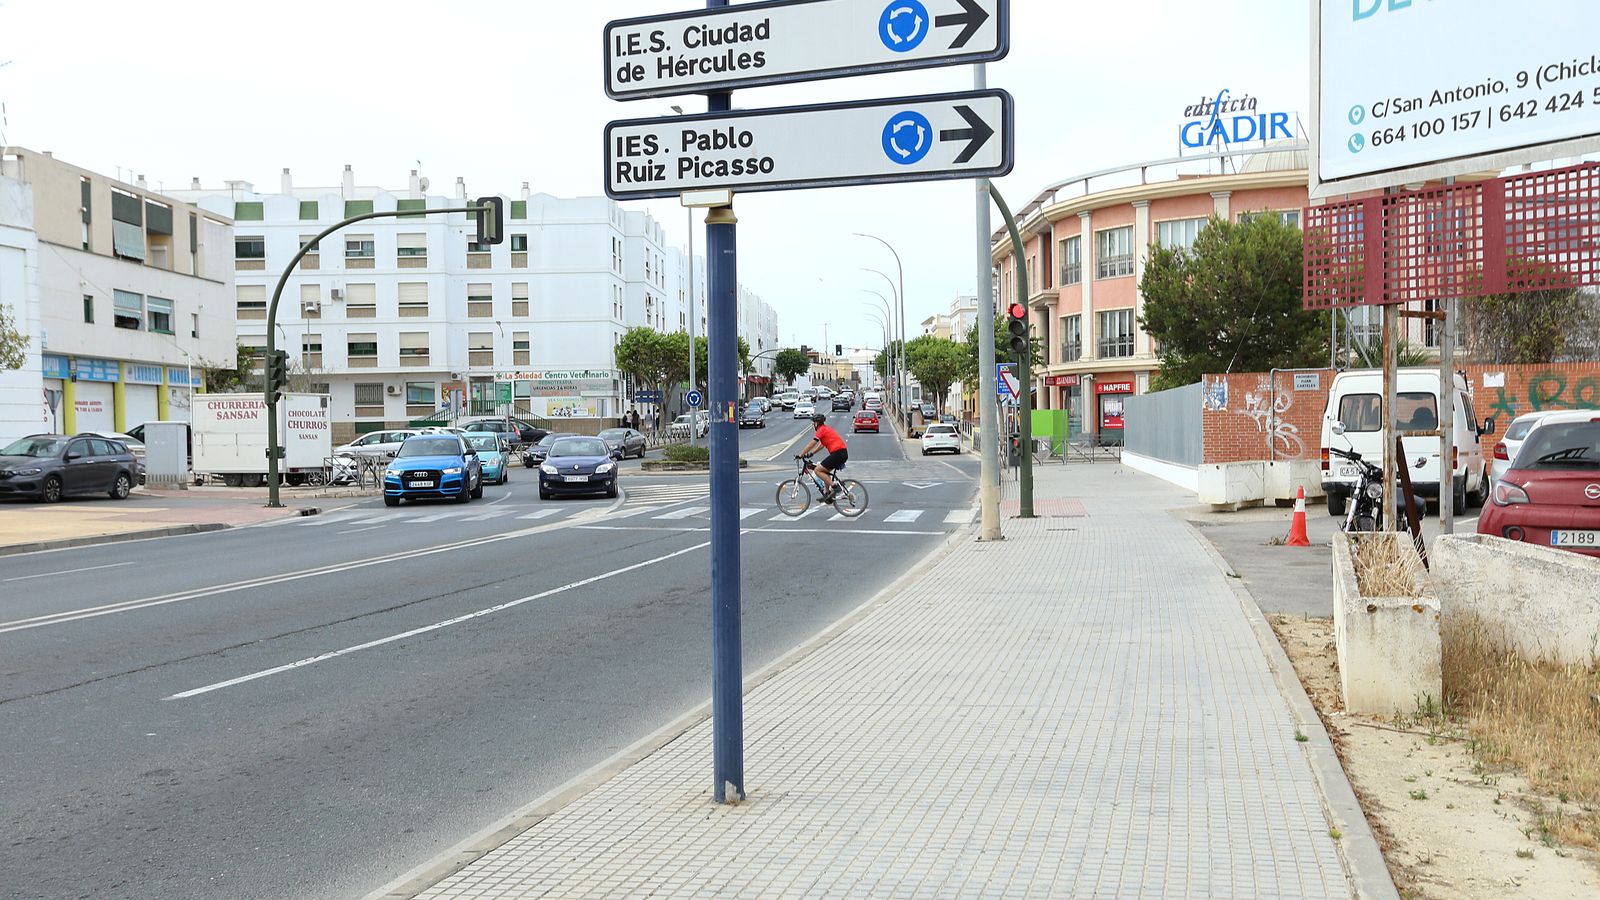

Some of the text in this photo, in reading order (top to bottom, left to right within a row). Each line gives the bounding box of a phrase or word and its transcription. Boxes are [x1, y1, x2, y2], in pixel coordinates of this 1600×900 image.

[616, 18, 770, 57] I.E.S. Ciudad
[617, 49, 766, 83] de Hércules
[1429, 78, 1509, 107] Antonio,
[1516, 71, 1528, 88] 9
[1184, 89, 1258, 131] edificio
[1371, 125, 1406, 147] 664
[1412, 118, 1445, 139] 100
[1452, 110, 1481, 131] 157
[1499, 99, 1538, 122] 642
[1545, 90, 1584, 113] 424
[682, 126, 753, 152] Pablo
[1181, 112, 1294, 148] GADIR
[616, 156, 774, 183] Ruiz Picasso
[514, 371, 542, 379] Soledad
[544, 371, 568, 379] Centro
[569, 370, 609, 379] Veterinario
[1103, 383, 1131, 392] MAPFRE
[208, 401, 266, 409] CHURRERIA
[216, 411, 258, 420] SANSAN
[288, 420, 327, 429] CHURROS
[1560, 531, 1595, 544] 2189
